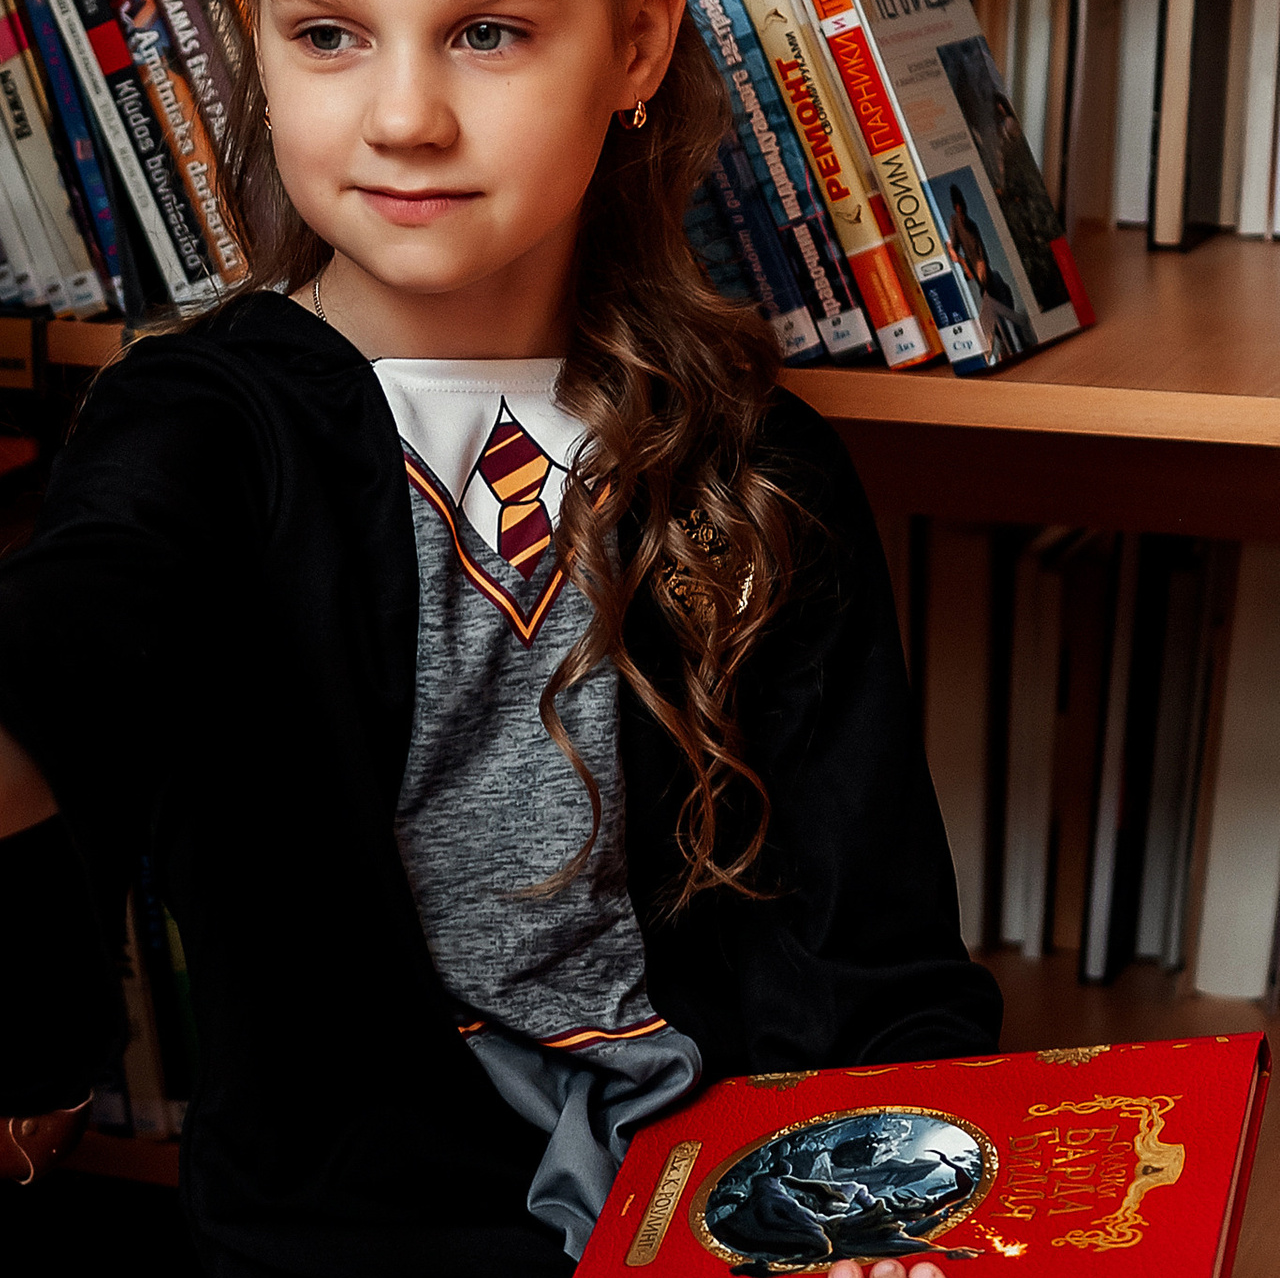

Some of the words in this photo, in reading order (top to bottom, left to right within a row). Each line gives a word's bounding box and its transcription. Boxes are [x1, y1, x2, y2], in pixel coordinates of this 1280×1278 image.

[133, 29, 194, 156] Amatnieka
[785, 31, 815, 82] РУКАМИ
[834, 31, 895, 150] ПАРНИКИ
[115, 79, 155, 153] Kļūdas
[775, 57, 851, 203] РЕМОНТ
[807, 81, 834, 136] СВОИМИ
[881, 153, 936, 257] СТРОИМ
[989, 1126, 1061, 1222] БИДЛЯ
[1047, 1124, 1119, 1216] БАРДА
[636, 1191, 674, 1249] РОУЛИНГ
